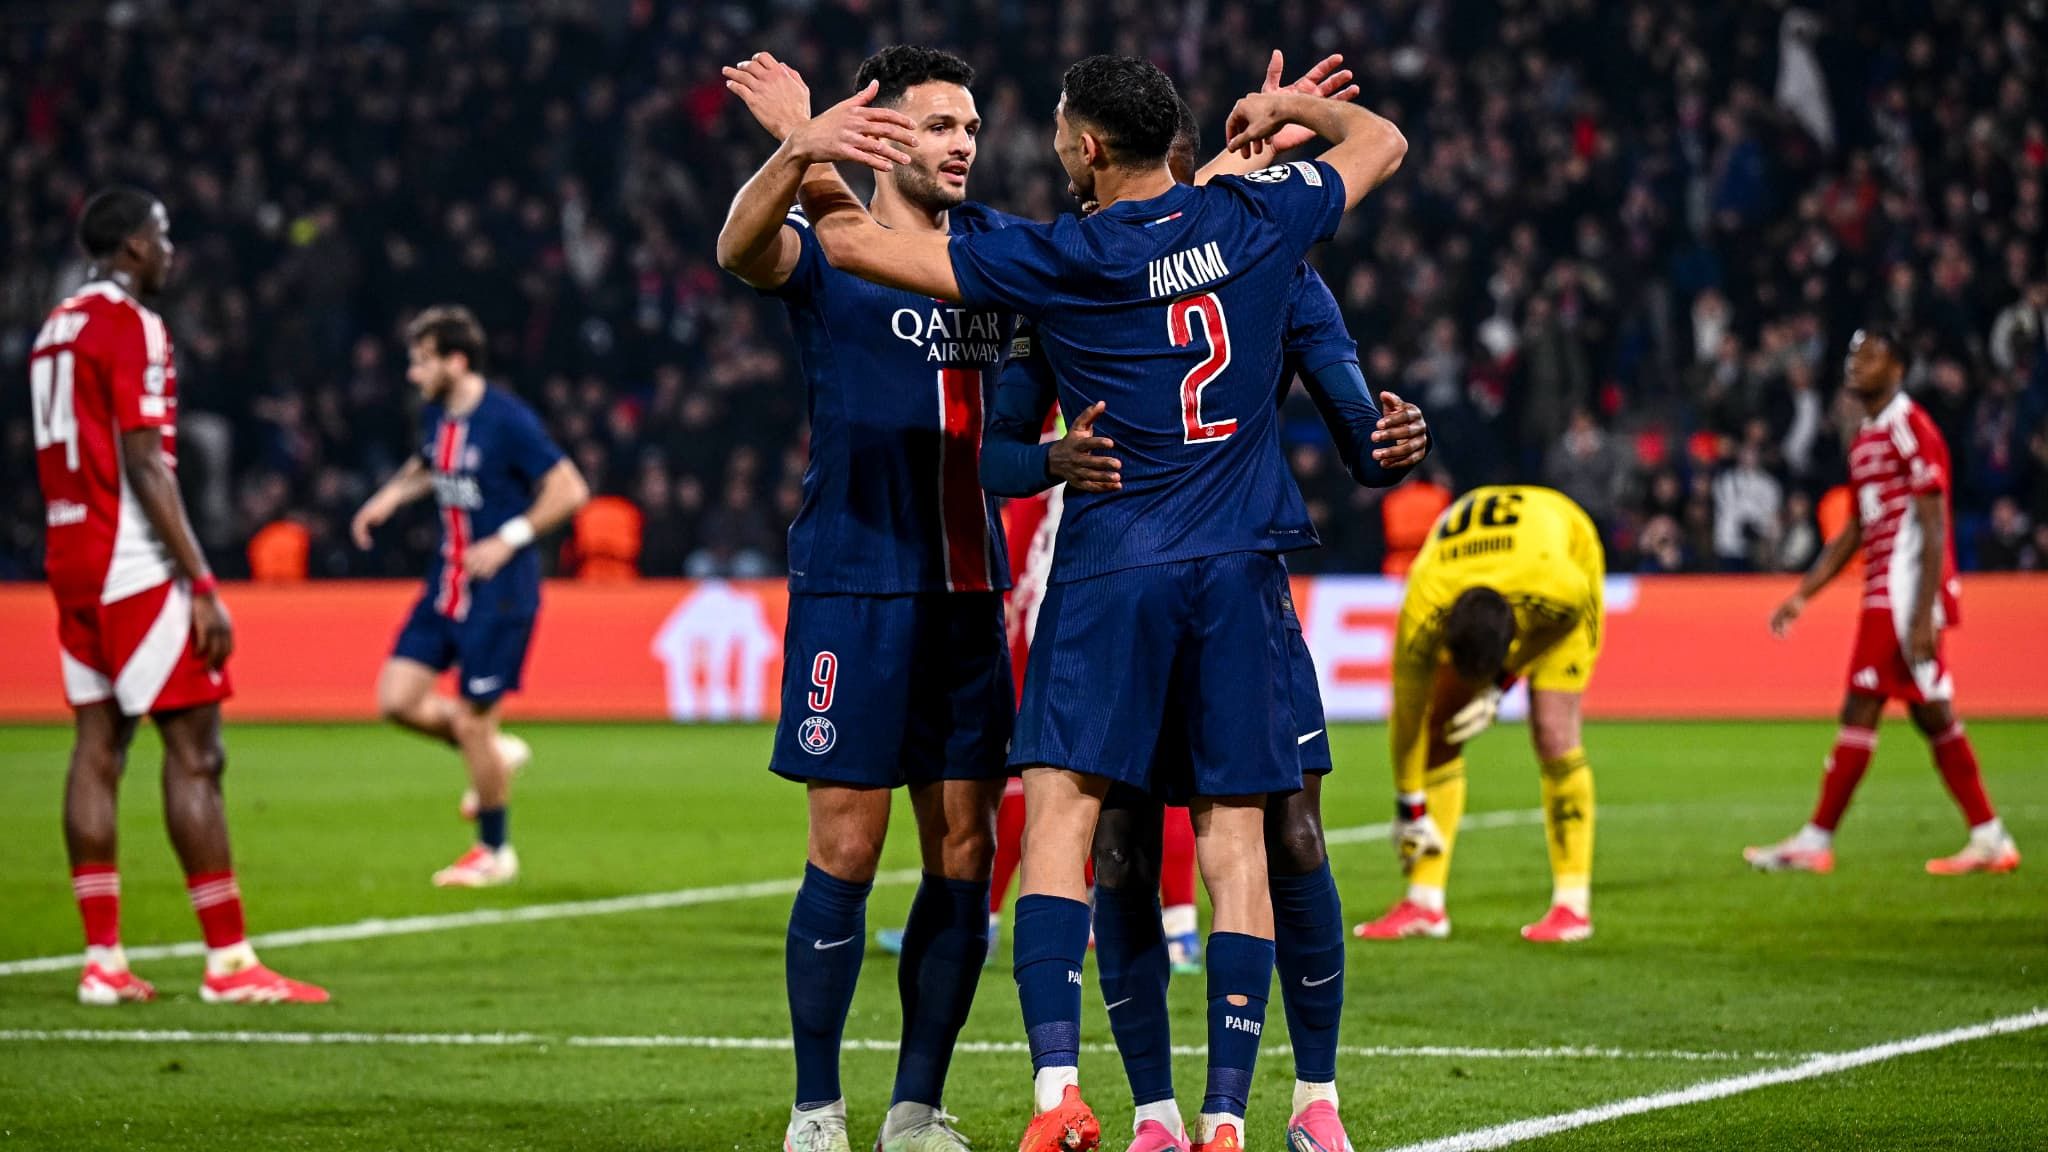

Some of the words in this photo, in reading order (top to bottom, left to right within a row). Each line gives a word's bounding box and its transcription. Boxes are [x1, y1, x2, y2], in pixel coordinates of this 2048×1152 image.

[1149, 241, 1230, 298] HAKIMI
[891, 308, 1001, 347] QATAR
[926, 342, 1000, 363] AIRWAYS
[1167, 292, 1238, 445] 2
[30, 350, 80, 472] 14
[808, 651, 838, 712] 9
[805, 717, 831, 729] PARIS
[1225, 1015, 1261, 1036] PARIS
